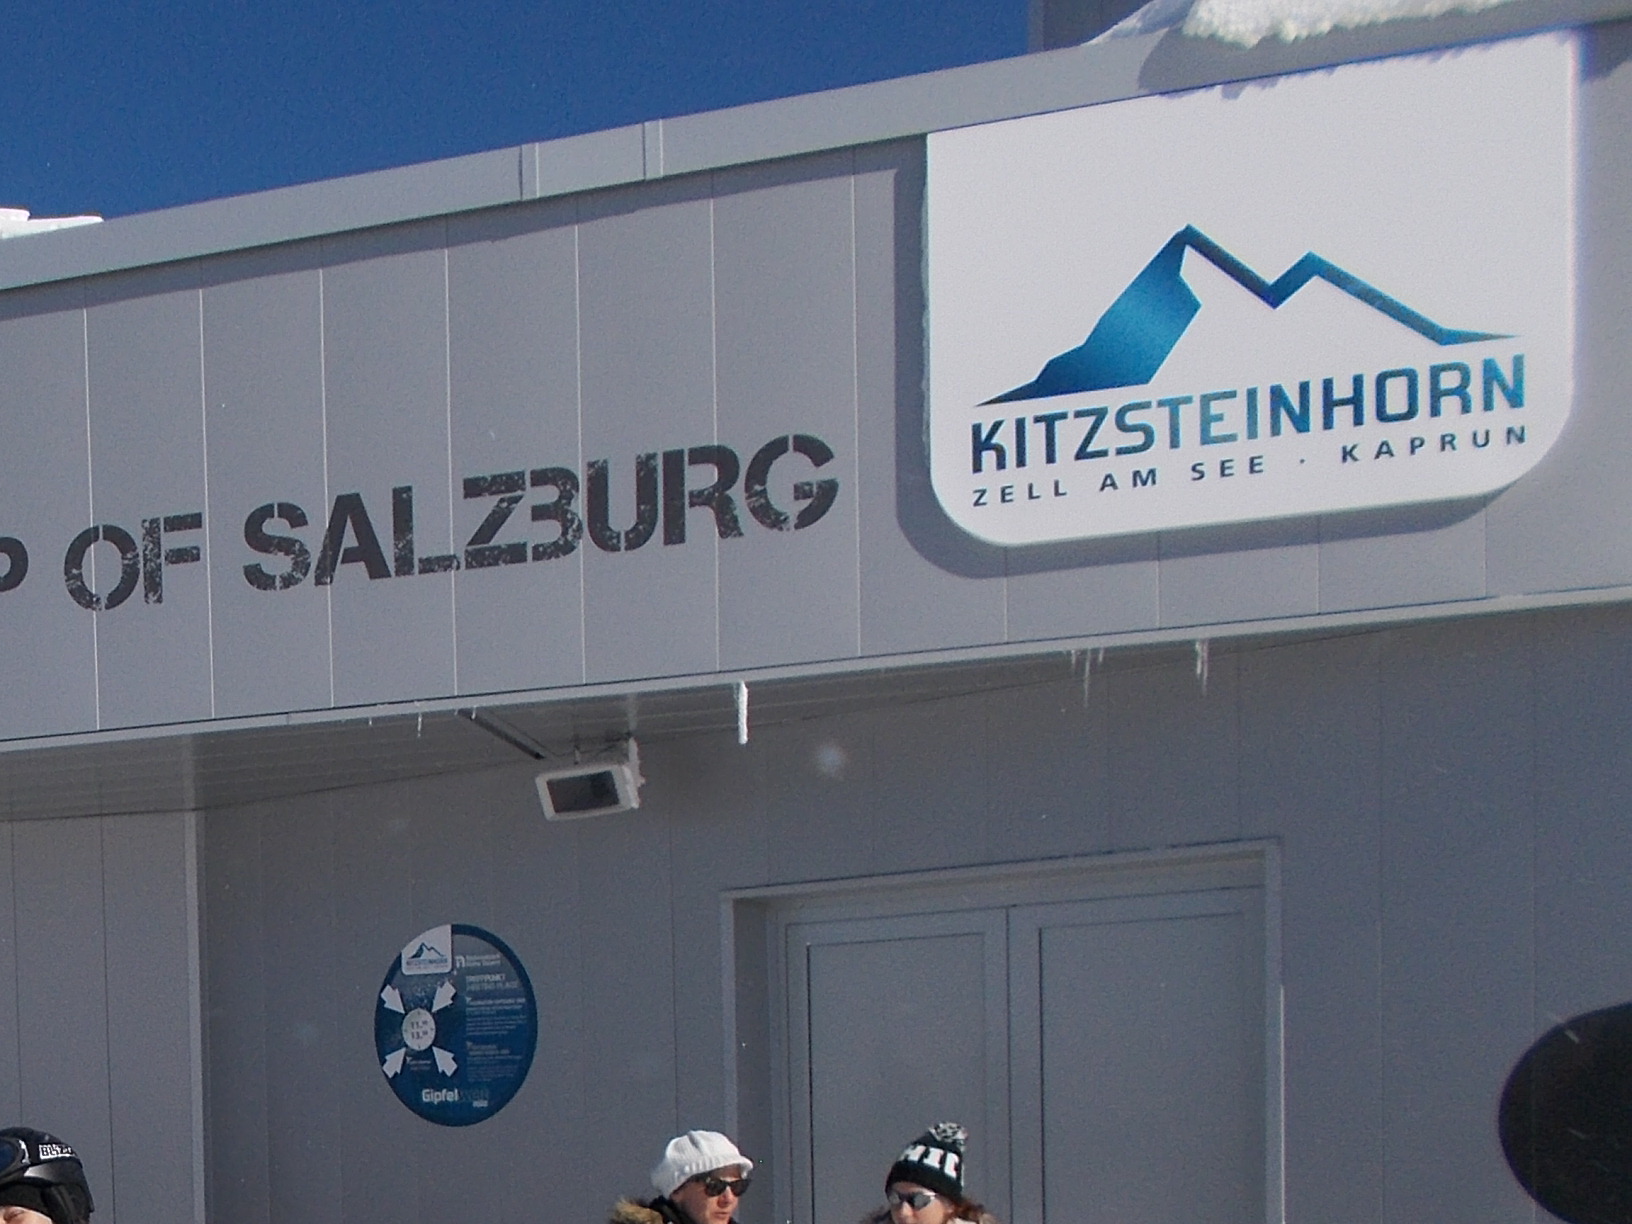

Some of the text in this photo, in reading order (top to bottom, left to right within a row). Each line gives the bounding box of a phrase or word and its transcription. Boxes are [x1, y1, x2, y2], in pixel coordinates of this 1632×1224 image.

[971, 353, 1525, 475] KITZSTEINHORN
[972, 424, 1527, 507] ZELL AM SEE KAPRUN
[64, 511, 203, 612] OF
[242, 434, 839, 591] SALZBURG
